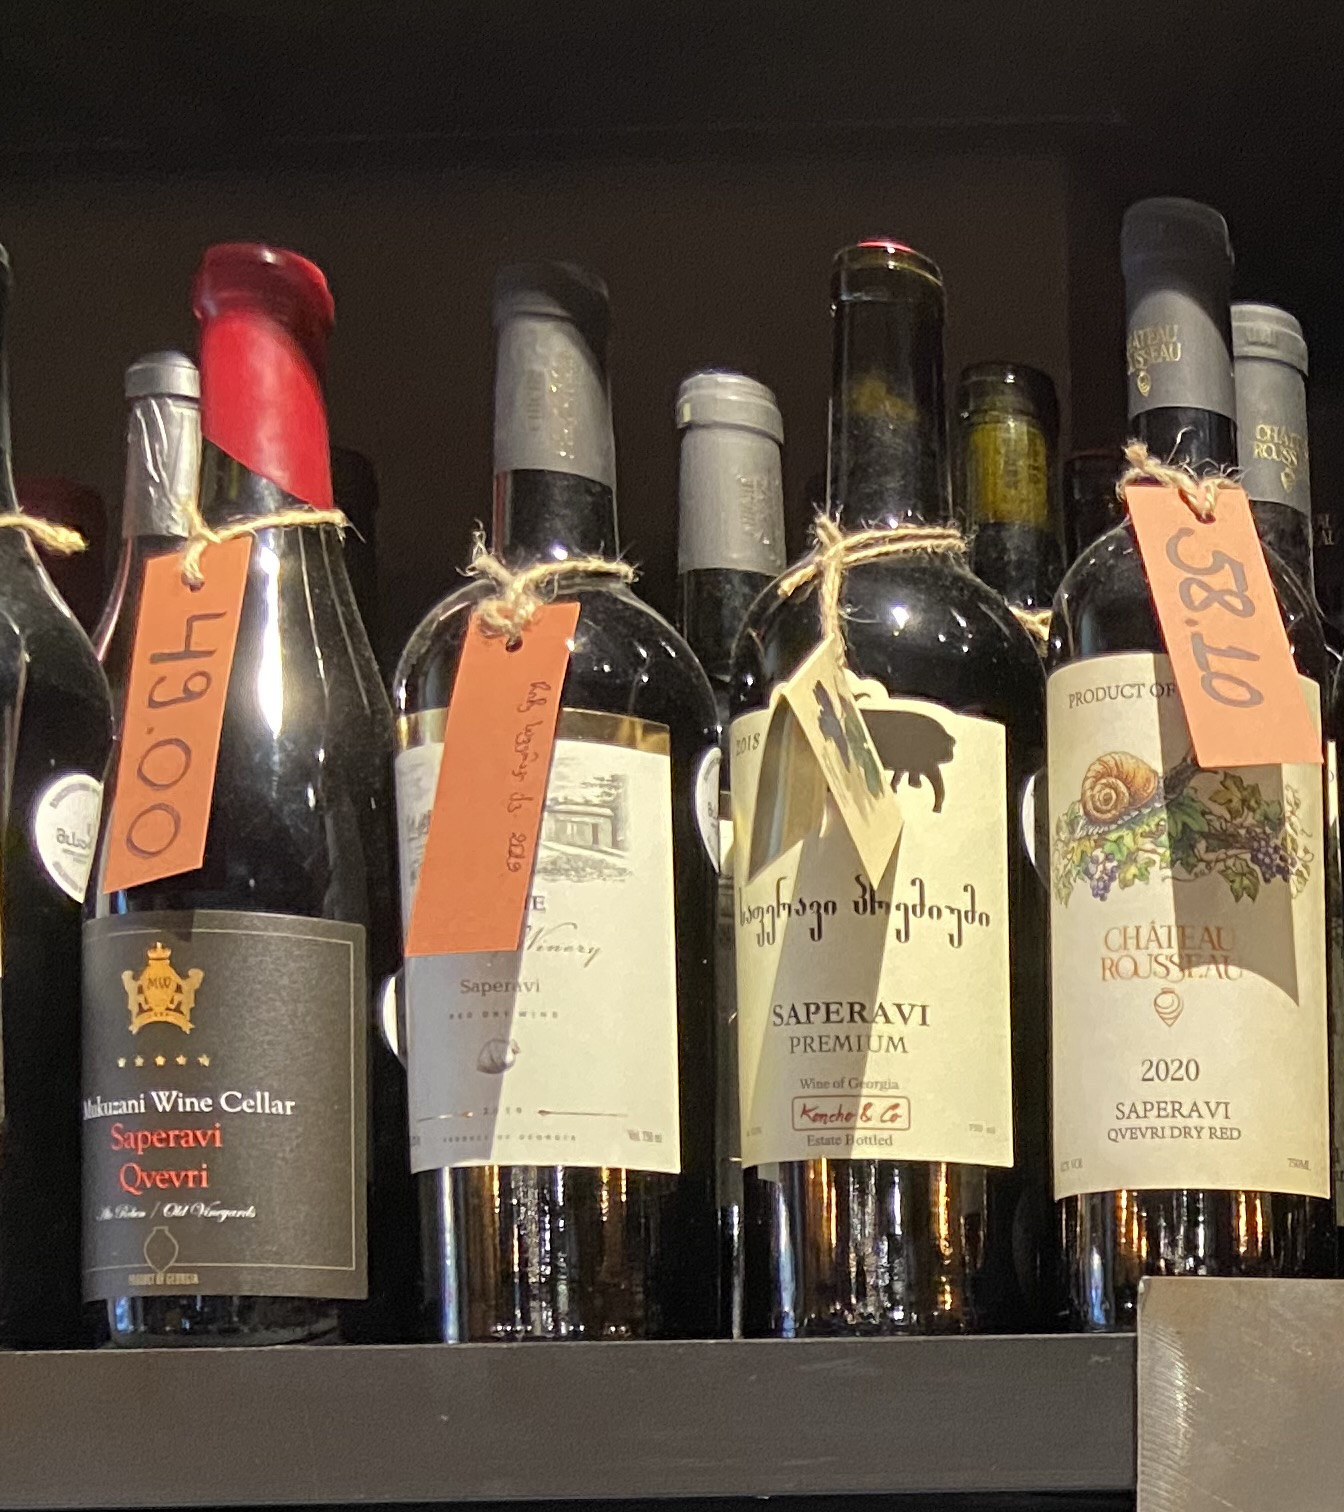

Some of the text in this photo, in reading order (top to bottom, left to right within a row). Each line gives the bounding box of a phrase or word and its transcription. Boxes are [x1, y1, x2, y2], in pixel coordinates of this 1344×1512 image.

[1166, 527, 1265, 708] 58.10
[1068, 682, 1176, 709] PRODUCT OF
[127, 612, 227, 858] 49.00
[739, 874, 838, 948] საფერავი
[1101, 952, 1243, 983] ROUSSEAU
[460, 978, 541, 995] Saperavi
[772, 1001, 931, 1028] SAPERAVI
[789, 1035, 909, 1055] PREMIUM
[1141, 1058, 1200, 1082] 2020
[799, 1078, 900, 1092] Wine of Georgia
[151, 1090, 213, 1113] Wine
[220, 1090, 296, 1116] Cellar
[1115, 1101, 1231, 1120] SAPERAVI
[110, 1122, 224, 1155] Saperavi
[806, 1134, 893, 1147] Estate Bottled
[1107, 1126, 1241, 1143] QVEVRI DRY RED
[119, 1162, 210, 1196] Qvevri
[163, 1201, 257, 1223] Old Vineyards
